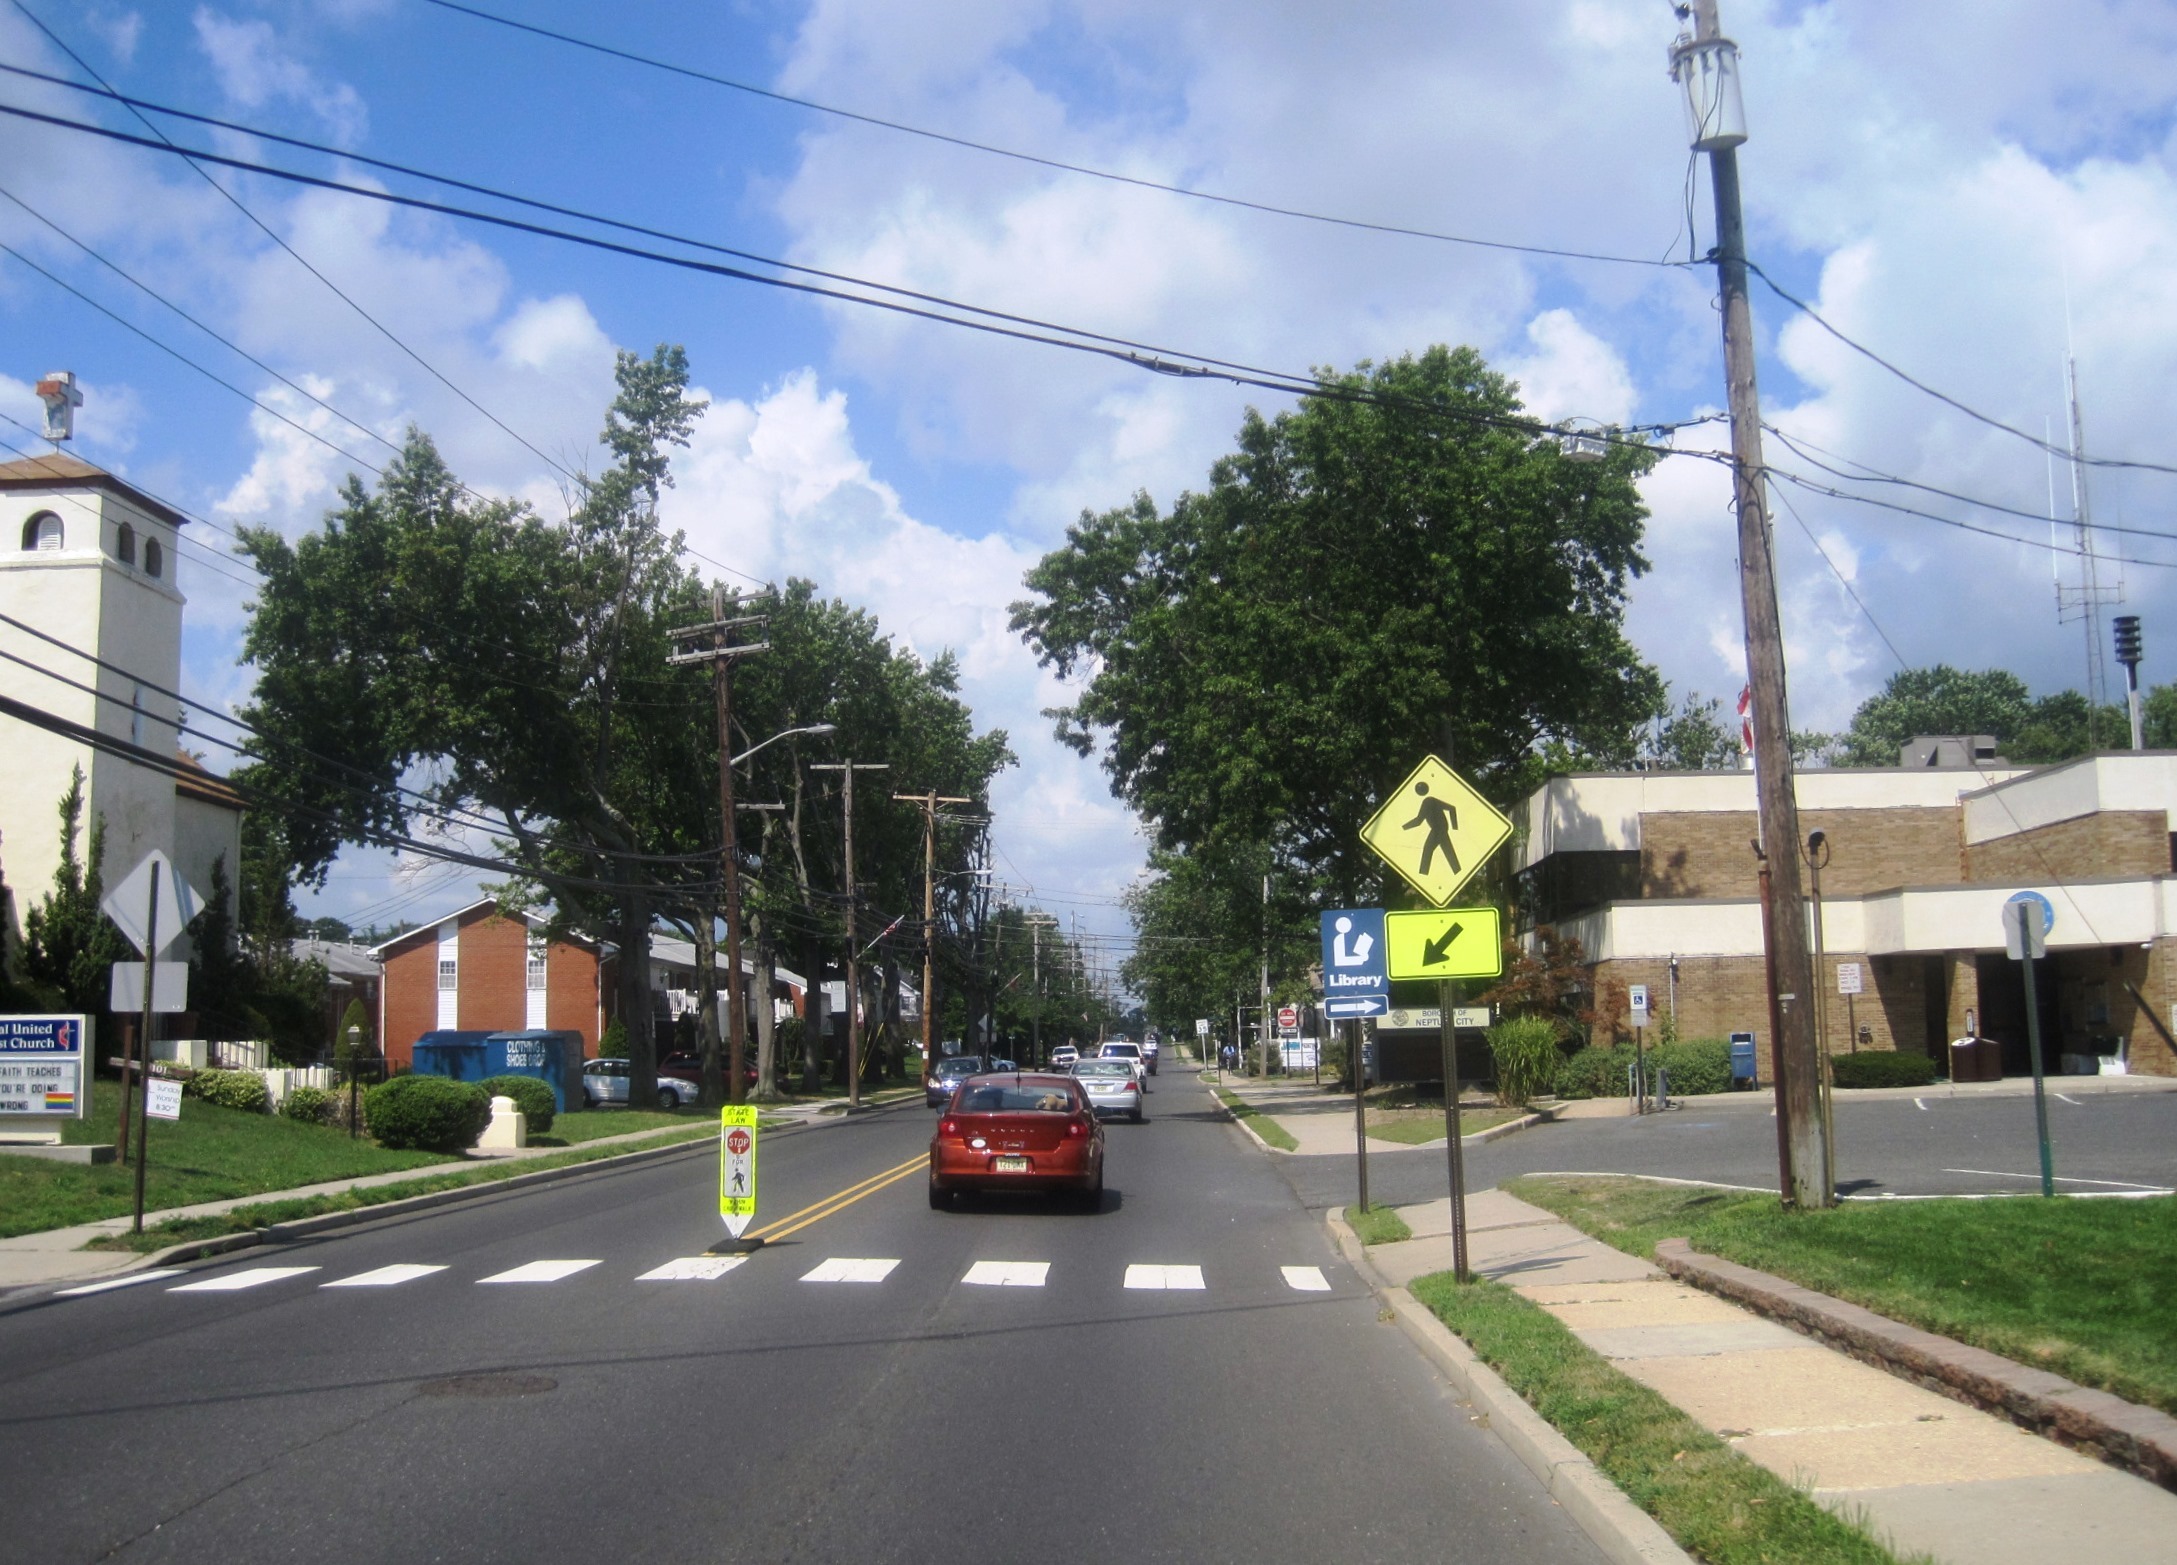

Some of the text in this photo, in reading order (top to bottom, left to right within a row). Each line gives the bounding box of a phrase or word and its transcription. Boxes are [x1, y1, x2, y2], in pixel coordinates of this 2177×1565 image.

[1329, 974, 1382, 988] Library
[1416, 1017, 1475, 1026] NEPTU CITY
[12, 1023, 53, 1035] United
[10, 1037, 55, 1049] Church
[507, 1040, 540, 1053] CLOTHING
[506, 1053, 527, 1067] SHOES
[27, 1066, 62, 1077] TEACHES
[151, 1064, 168, 1074] 101
[0, 1083, 58, 1094] OU'RE DOING
[0, 1100, 28, 1111] WRONG
[727, 1107, 750, 1116] STATE
[728, 1137, 749, 1148] STOP
